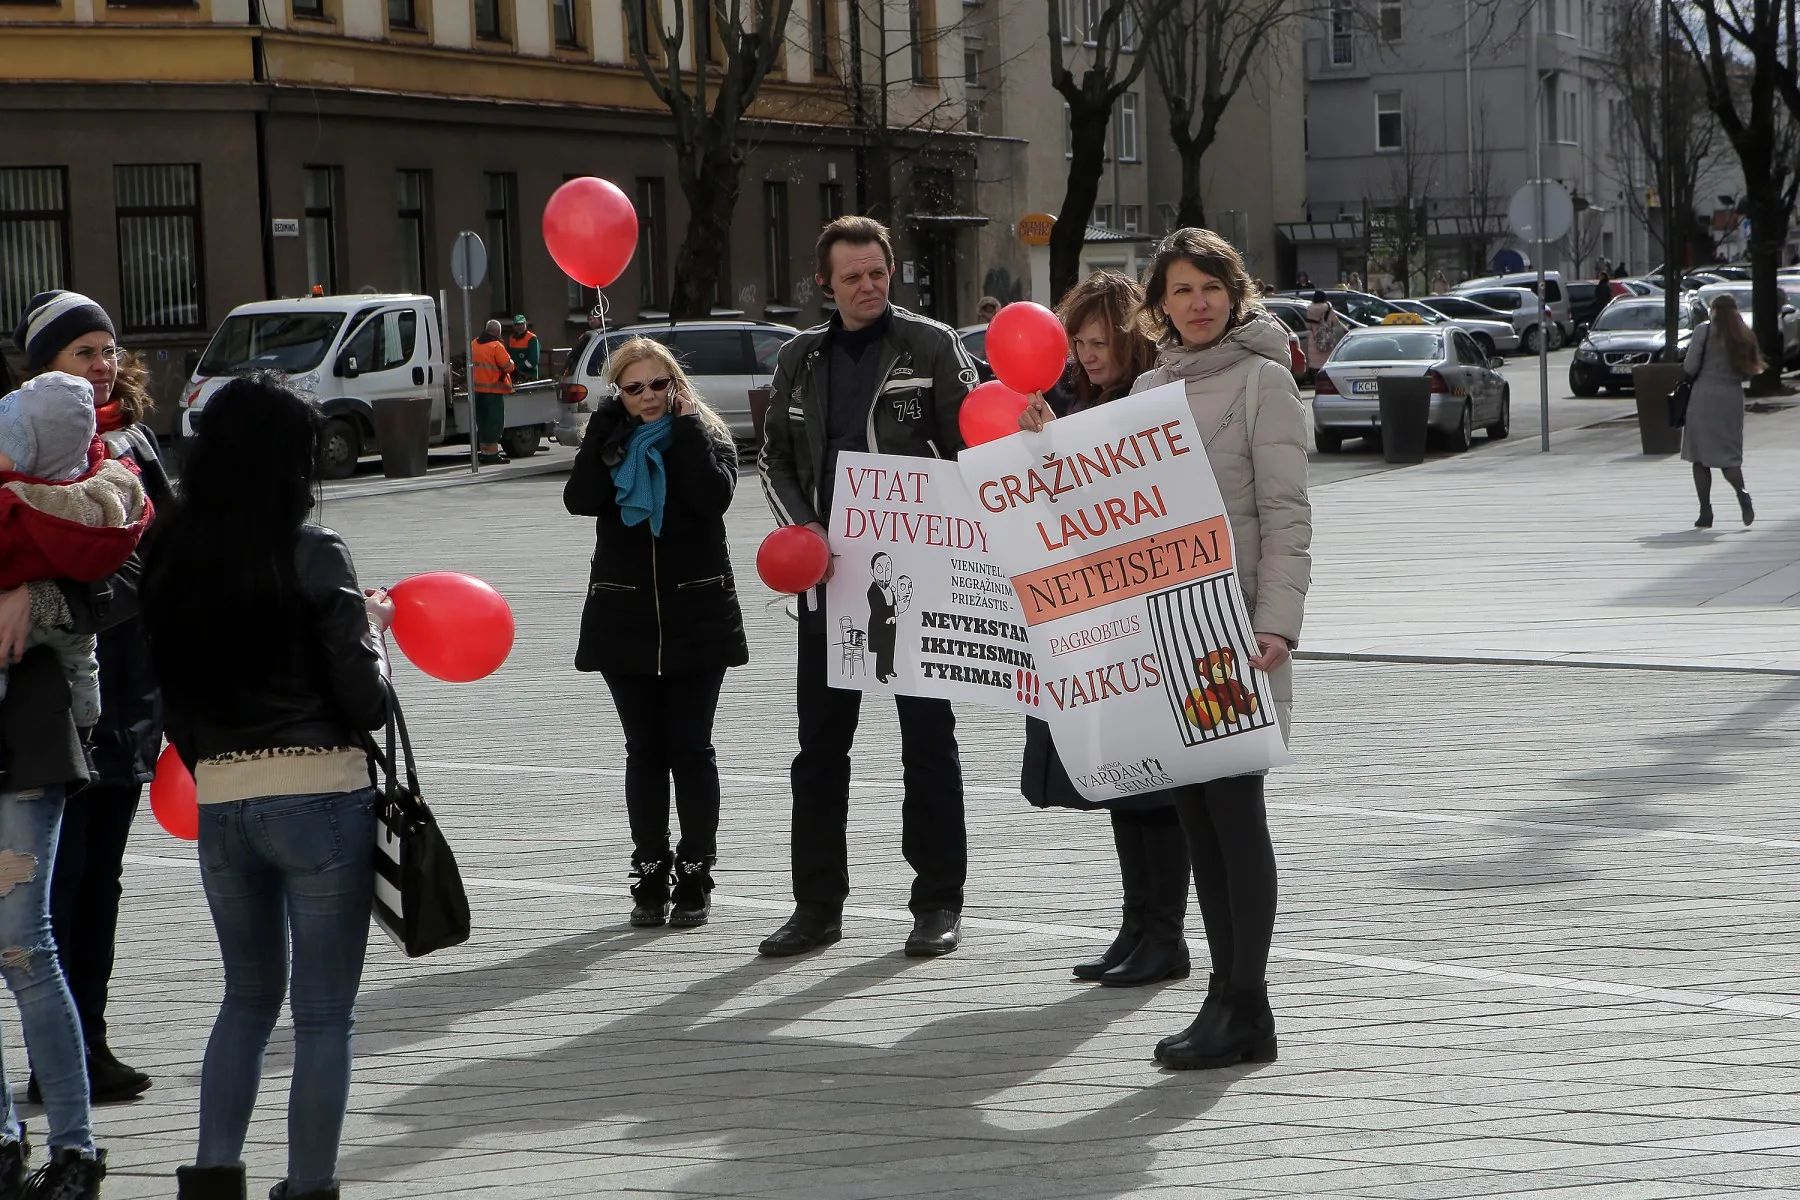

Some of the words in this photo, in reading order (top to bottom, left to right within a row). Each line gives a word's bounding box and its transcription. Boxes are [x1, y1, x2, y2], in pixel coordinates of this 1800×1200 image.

[1358, 382, 1377, 391] KCH
[893, 398, 921, 422] 74
[978, 419, 1190, 513] GRĄŽINKITE
[846, 467, 929, 503] VTAT
[844, 507, 988, 553] DVIVEIDY
[1036, 485, 1168, 551] LAURAI
[951, 559, 1006, 579] VIENINTEL
[1027, 529, 1222, 613] NETEISĖTAI
[952, 592, 1008, 612] PRIEŽASTIS
[1049, 615, 1141, 654] PAGROBTUS
[921, 662, 1012, 690] TYRIMAS
[1045, 652, 1161, 712] VAIKUS
[1076, 763, 1144, 788] VARDAN
[1113, 773, 1174, 794] ŠEIMOS
